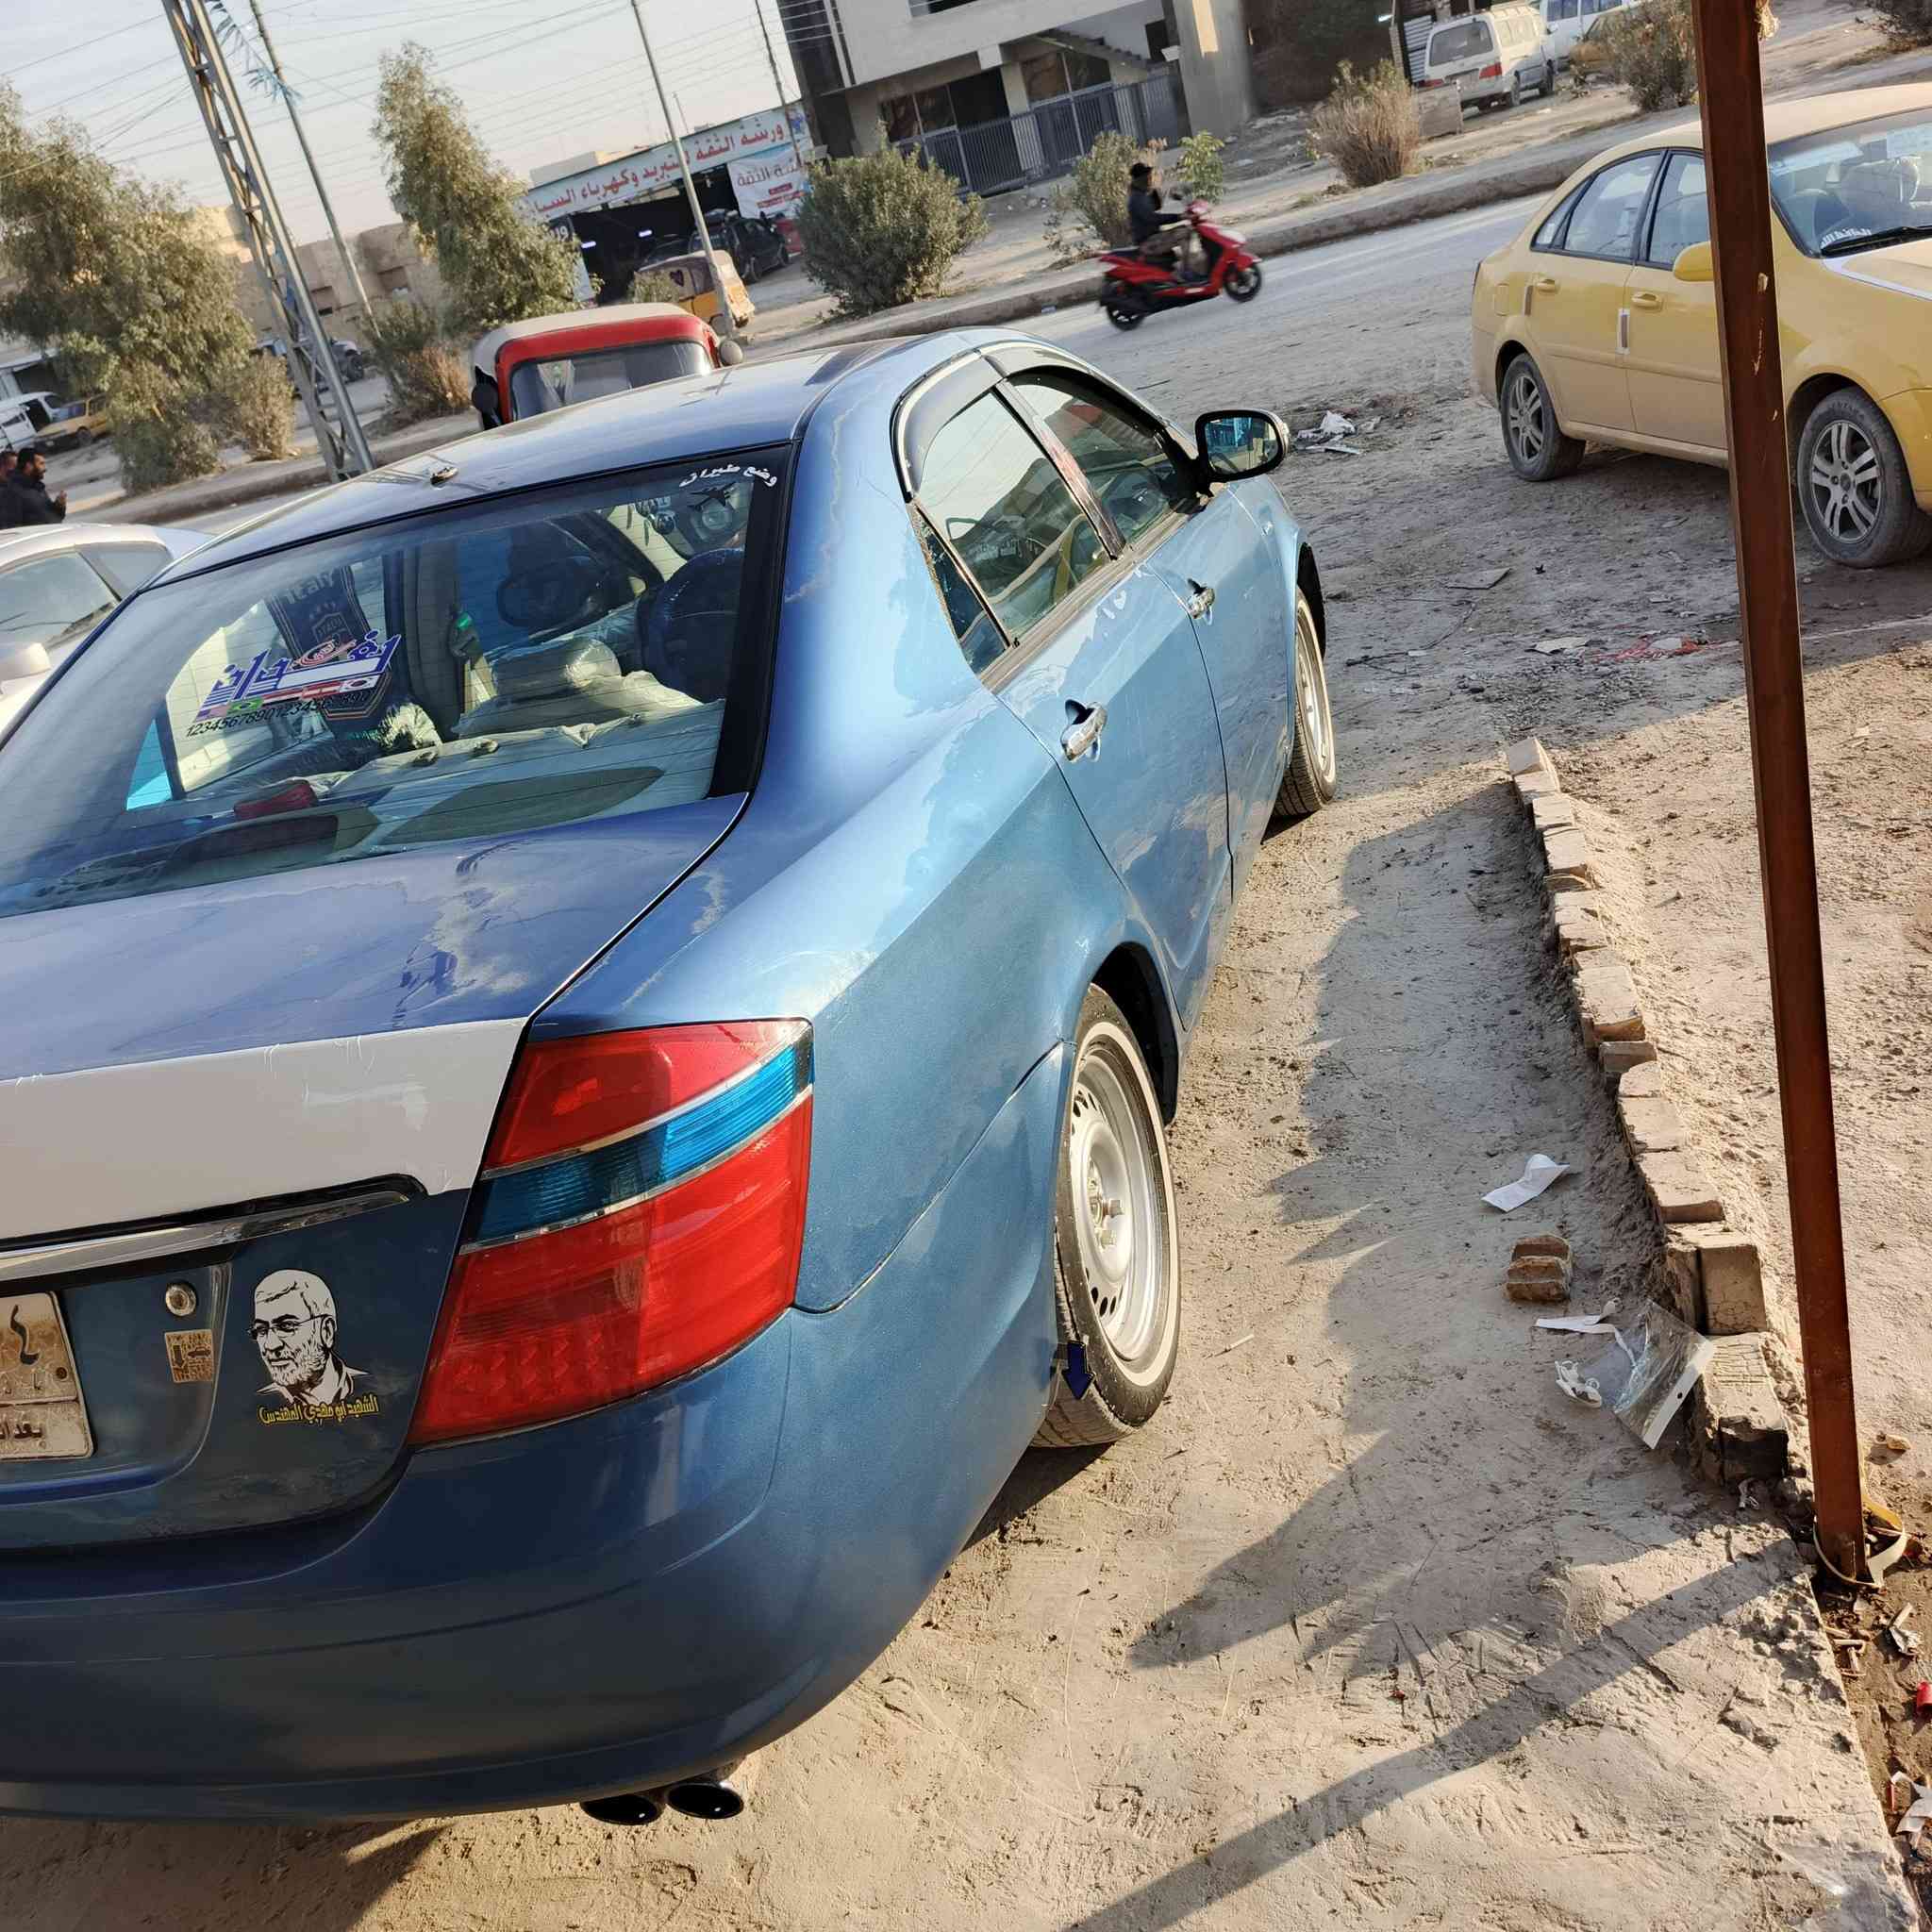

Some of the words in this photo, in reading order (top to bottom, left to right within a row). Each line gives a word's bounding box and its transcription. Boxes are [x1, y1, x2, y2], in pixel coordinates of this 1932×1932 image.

[741, 117, 785, 146] ورشة
[695, 134, 735, 160] الثقة
[643, 148, 691, 181] لتبريد
[580, 169, 640, 201] وكهرباء
[258, 1403, 303, 1424] المهندس
[303, 1402, 335, 1426] مهدي
[347, 1393, 379, 1418] الشهيد
